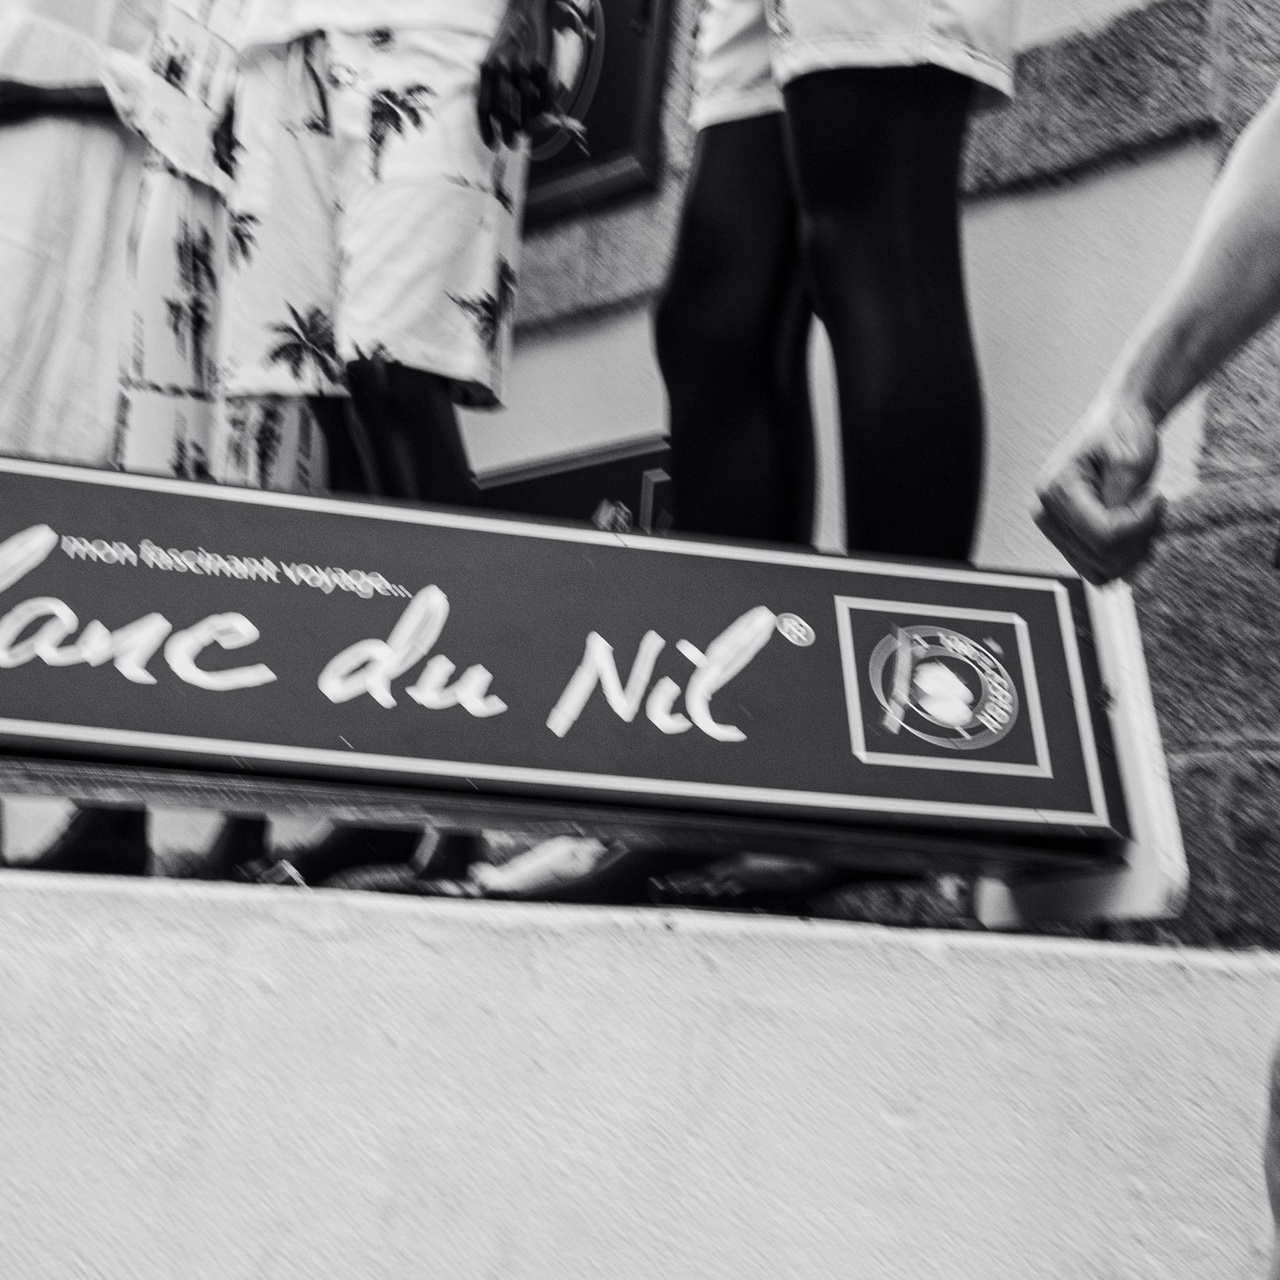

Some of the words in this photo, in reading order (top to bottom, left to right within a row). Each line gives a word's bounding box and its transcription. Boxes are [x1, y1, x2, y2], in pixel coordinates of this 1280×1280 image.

[61, 535, 138, 567] mon
[139, 538, 281, 584] fascinant
[318, 584, 508, 718] du
